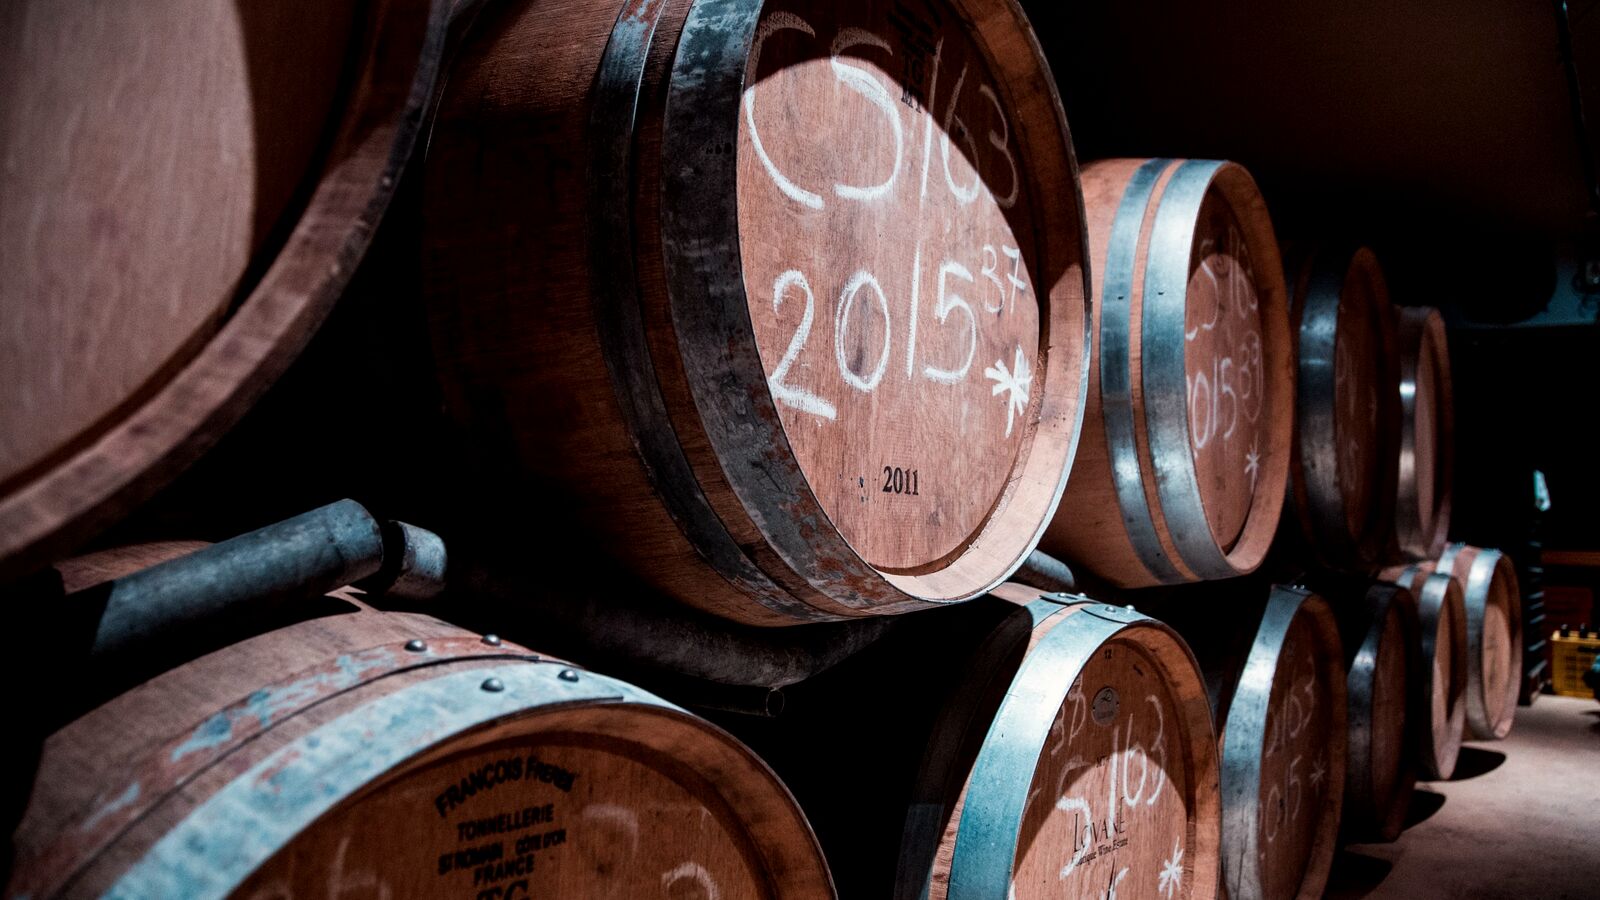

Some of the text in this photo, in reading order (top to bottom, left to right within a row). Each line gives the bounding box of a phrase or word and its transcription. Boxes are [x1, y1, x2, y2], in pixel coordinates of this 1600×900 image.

[767, 238, 978, 421] 2015
[882, 465, 919, 496] 2011
[473, 853, 535, 887] FRANCE
